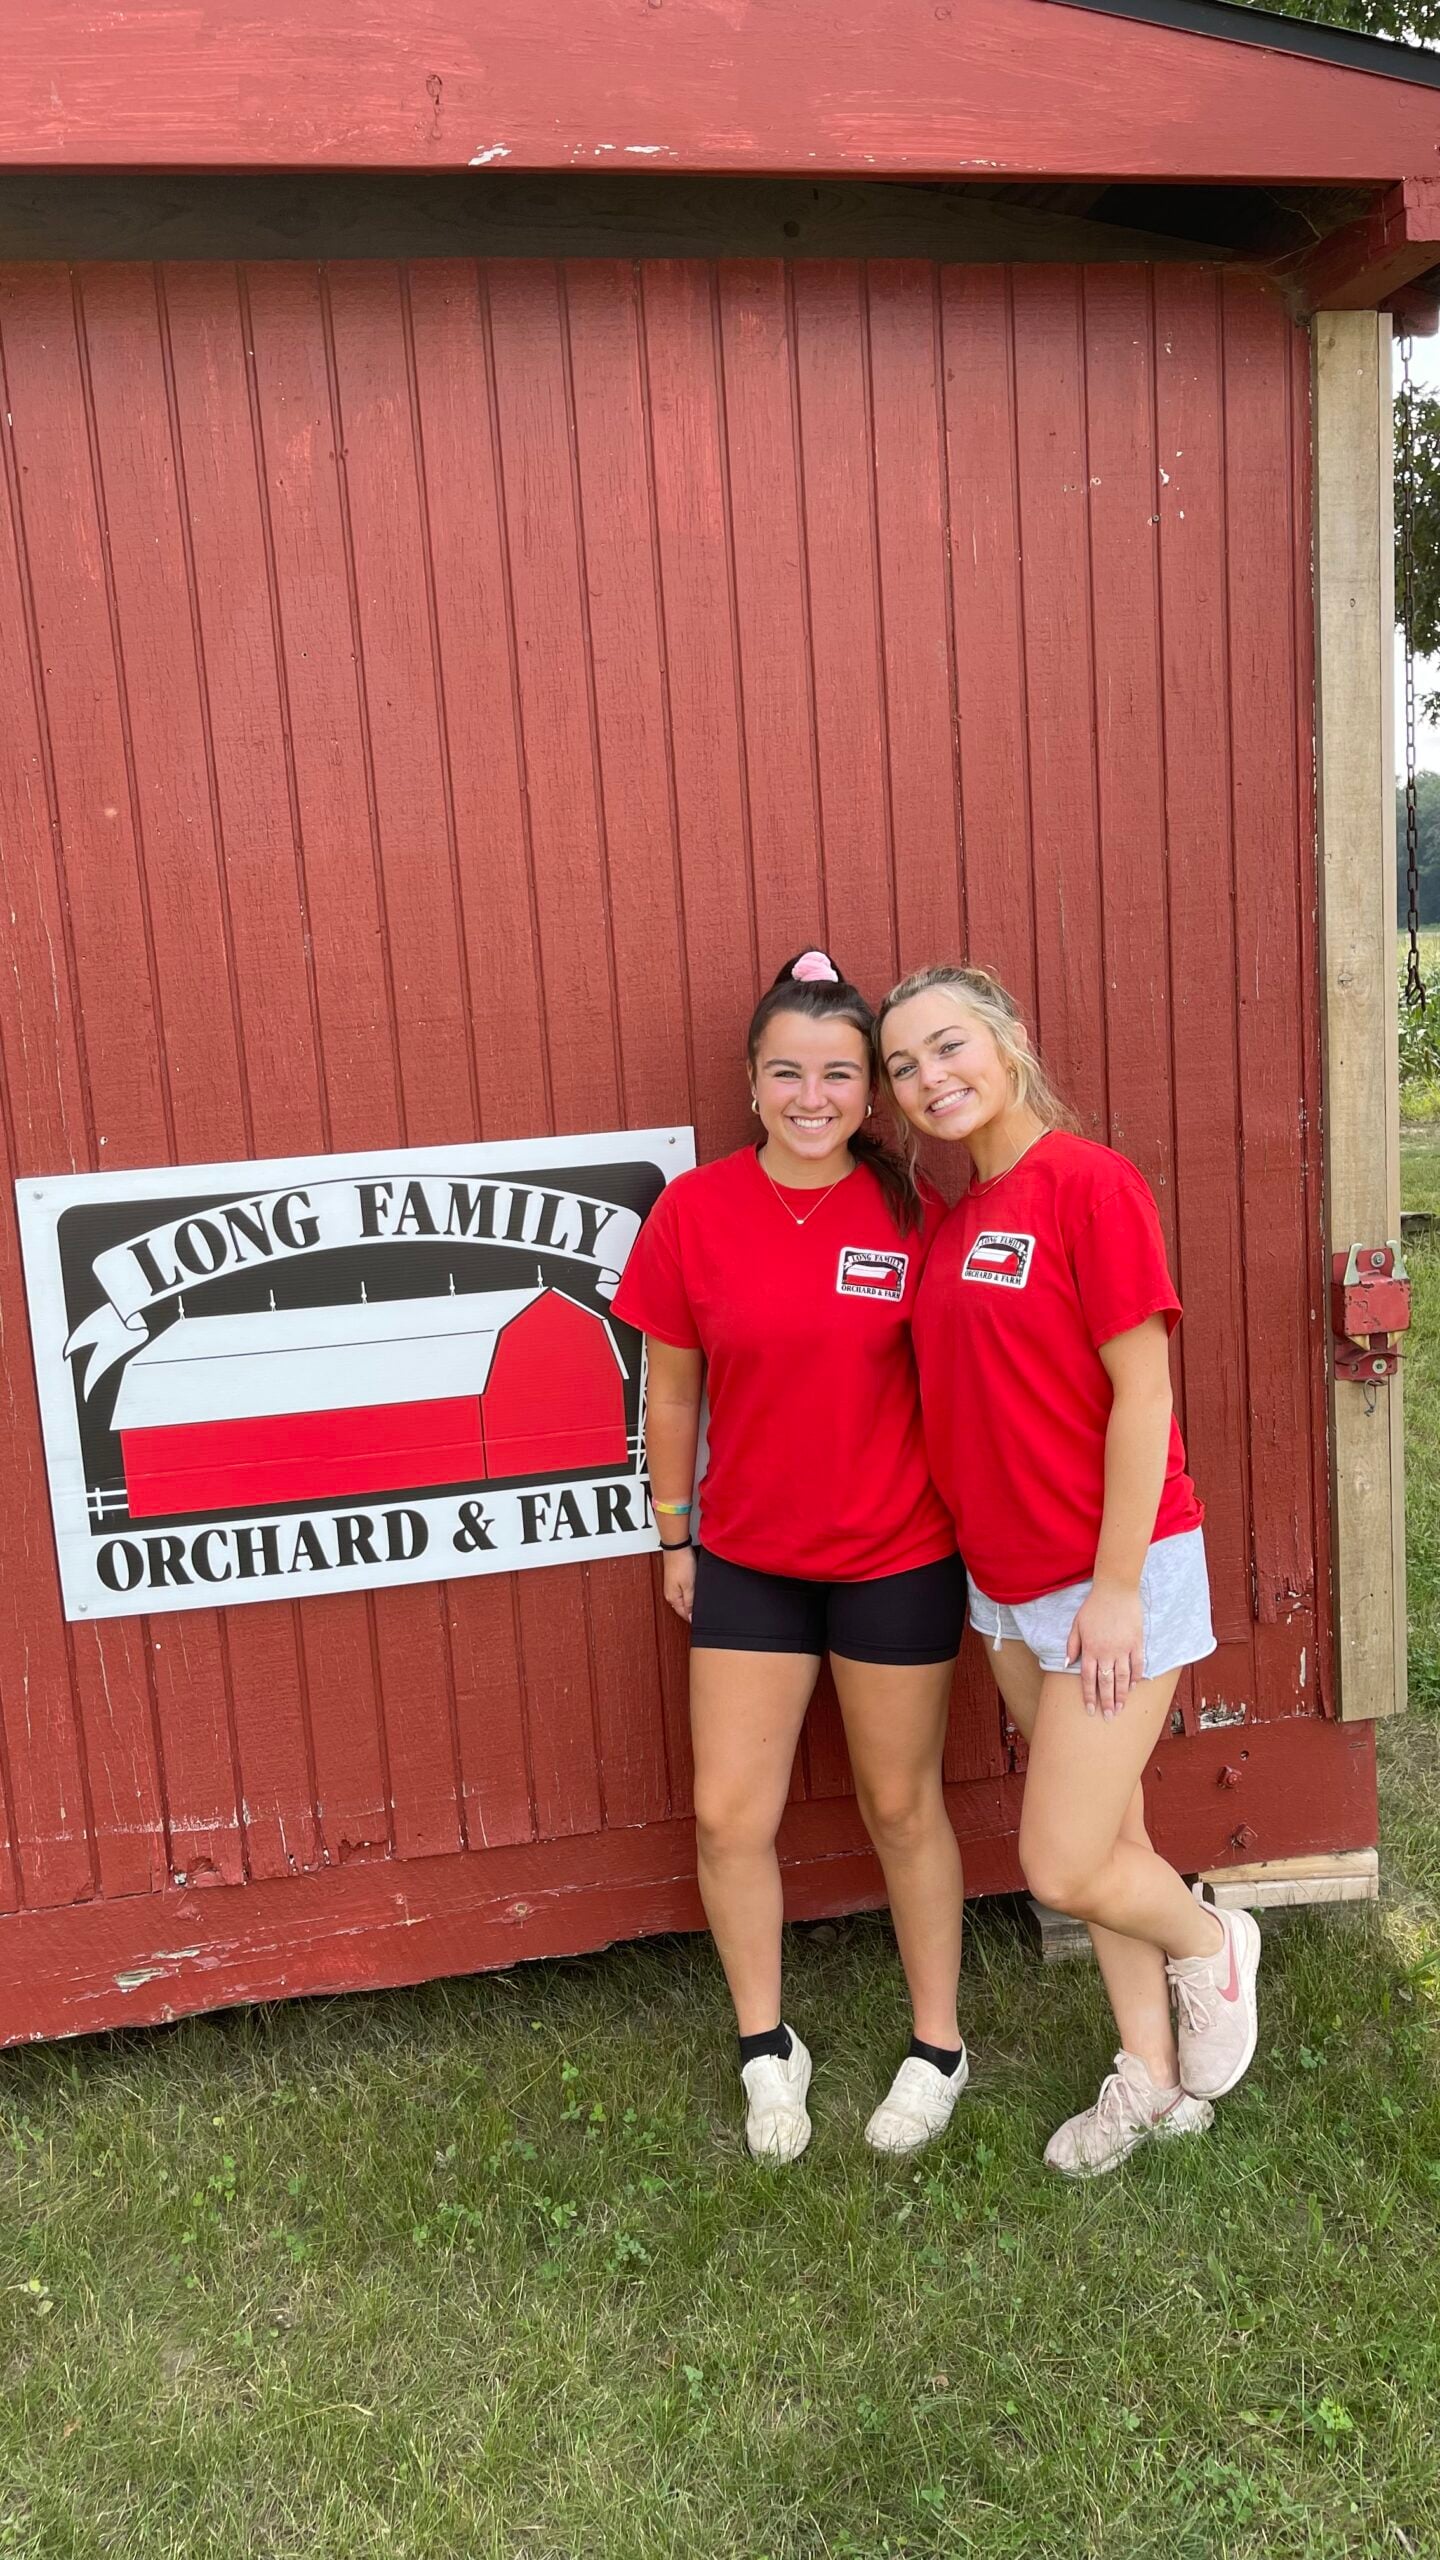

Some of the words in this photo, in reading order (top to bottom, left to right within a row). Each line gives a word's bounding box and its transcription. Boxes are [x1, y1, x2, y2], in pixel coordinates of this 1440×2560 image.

[127, 1189, 320, 1297] LONG
[354, 1181, 618, 1258] FAMILY
[981, 1236, 998, 1245] LONG
[999, 1236, 1022, 1250] FAMILY
[852, 1253, 872, 1262] LONG
[874, 1254, 900, 1268] FAMILY
[965, 1270, 992, 1280] ORCHARD
[1000, 1275, 1022, 1285] FARM
[841, 1285, 877, 1295] ORCHARD
[96, 1509, 429, 1592] ORCHARD
[453, 1501, 498, 1553] &
[516, 1480, 655, 1545] FAR
